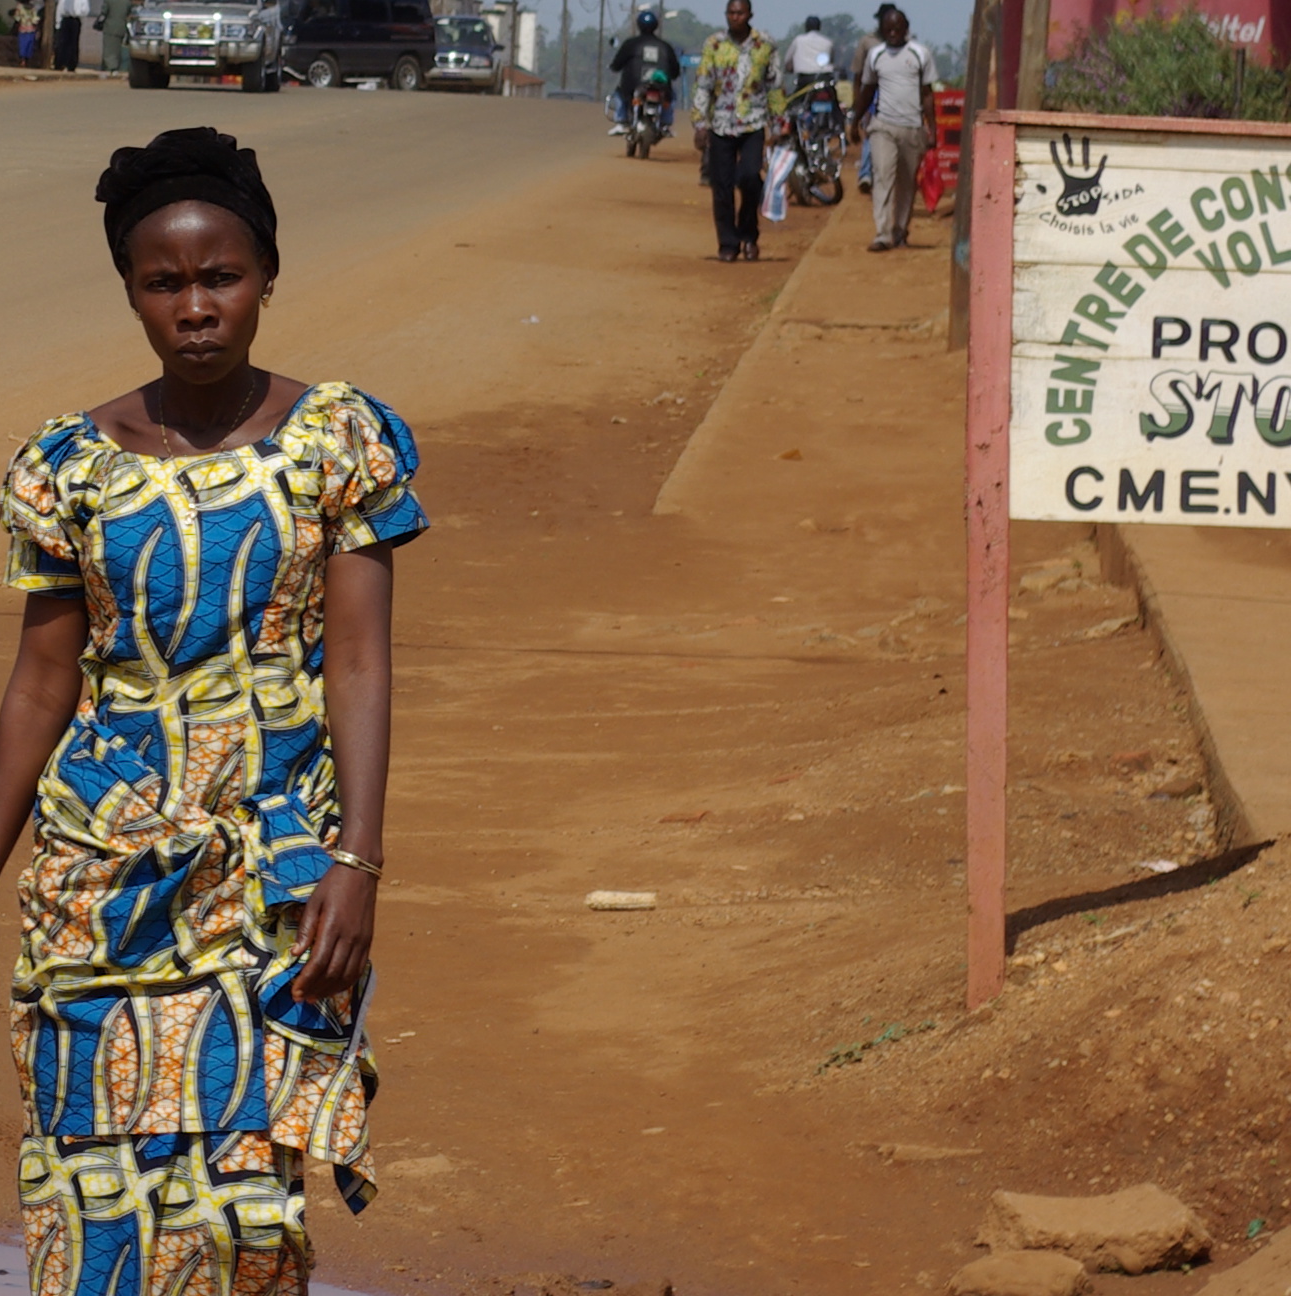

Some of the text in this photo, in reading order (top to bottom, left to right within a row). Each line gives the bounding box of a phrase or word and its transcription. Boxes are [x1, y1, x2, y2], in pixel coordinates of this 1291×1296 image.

[1058, 185, 1102, 212] STOP
[1039, 211, 1140, 235] Choisis la vie
[1045, 162, 1291, 446] CENTRE DE CON
[1151, 316, 1288, 365] PRO
